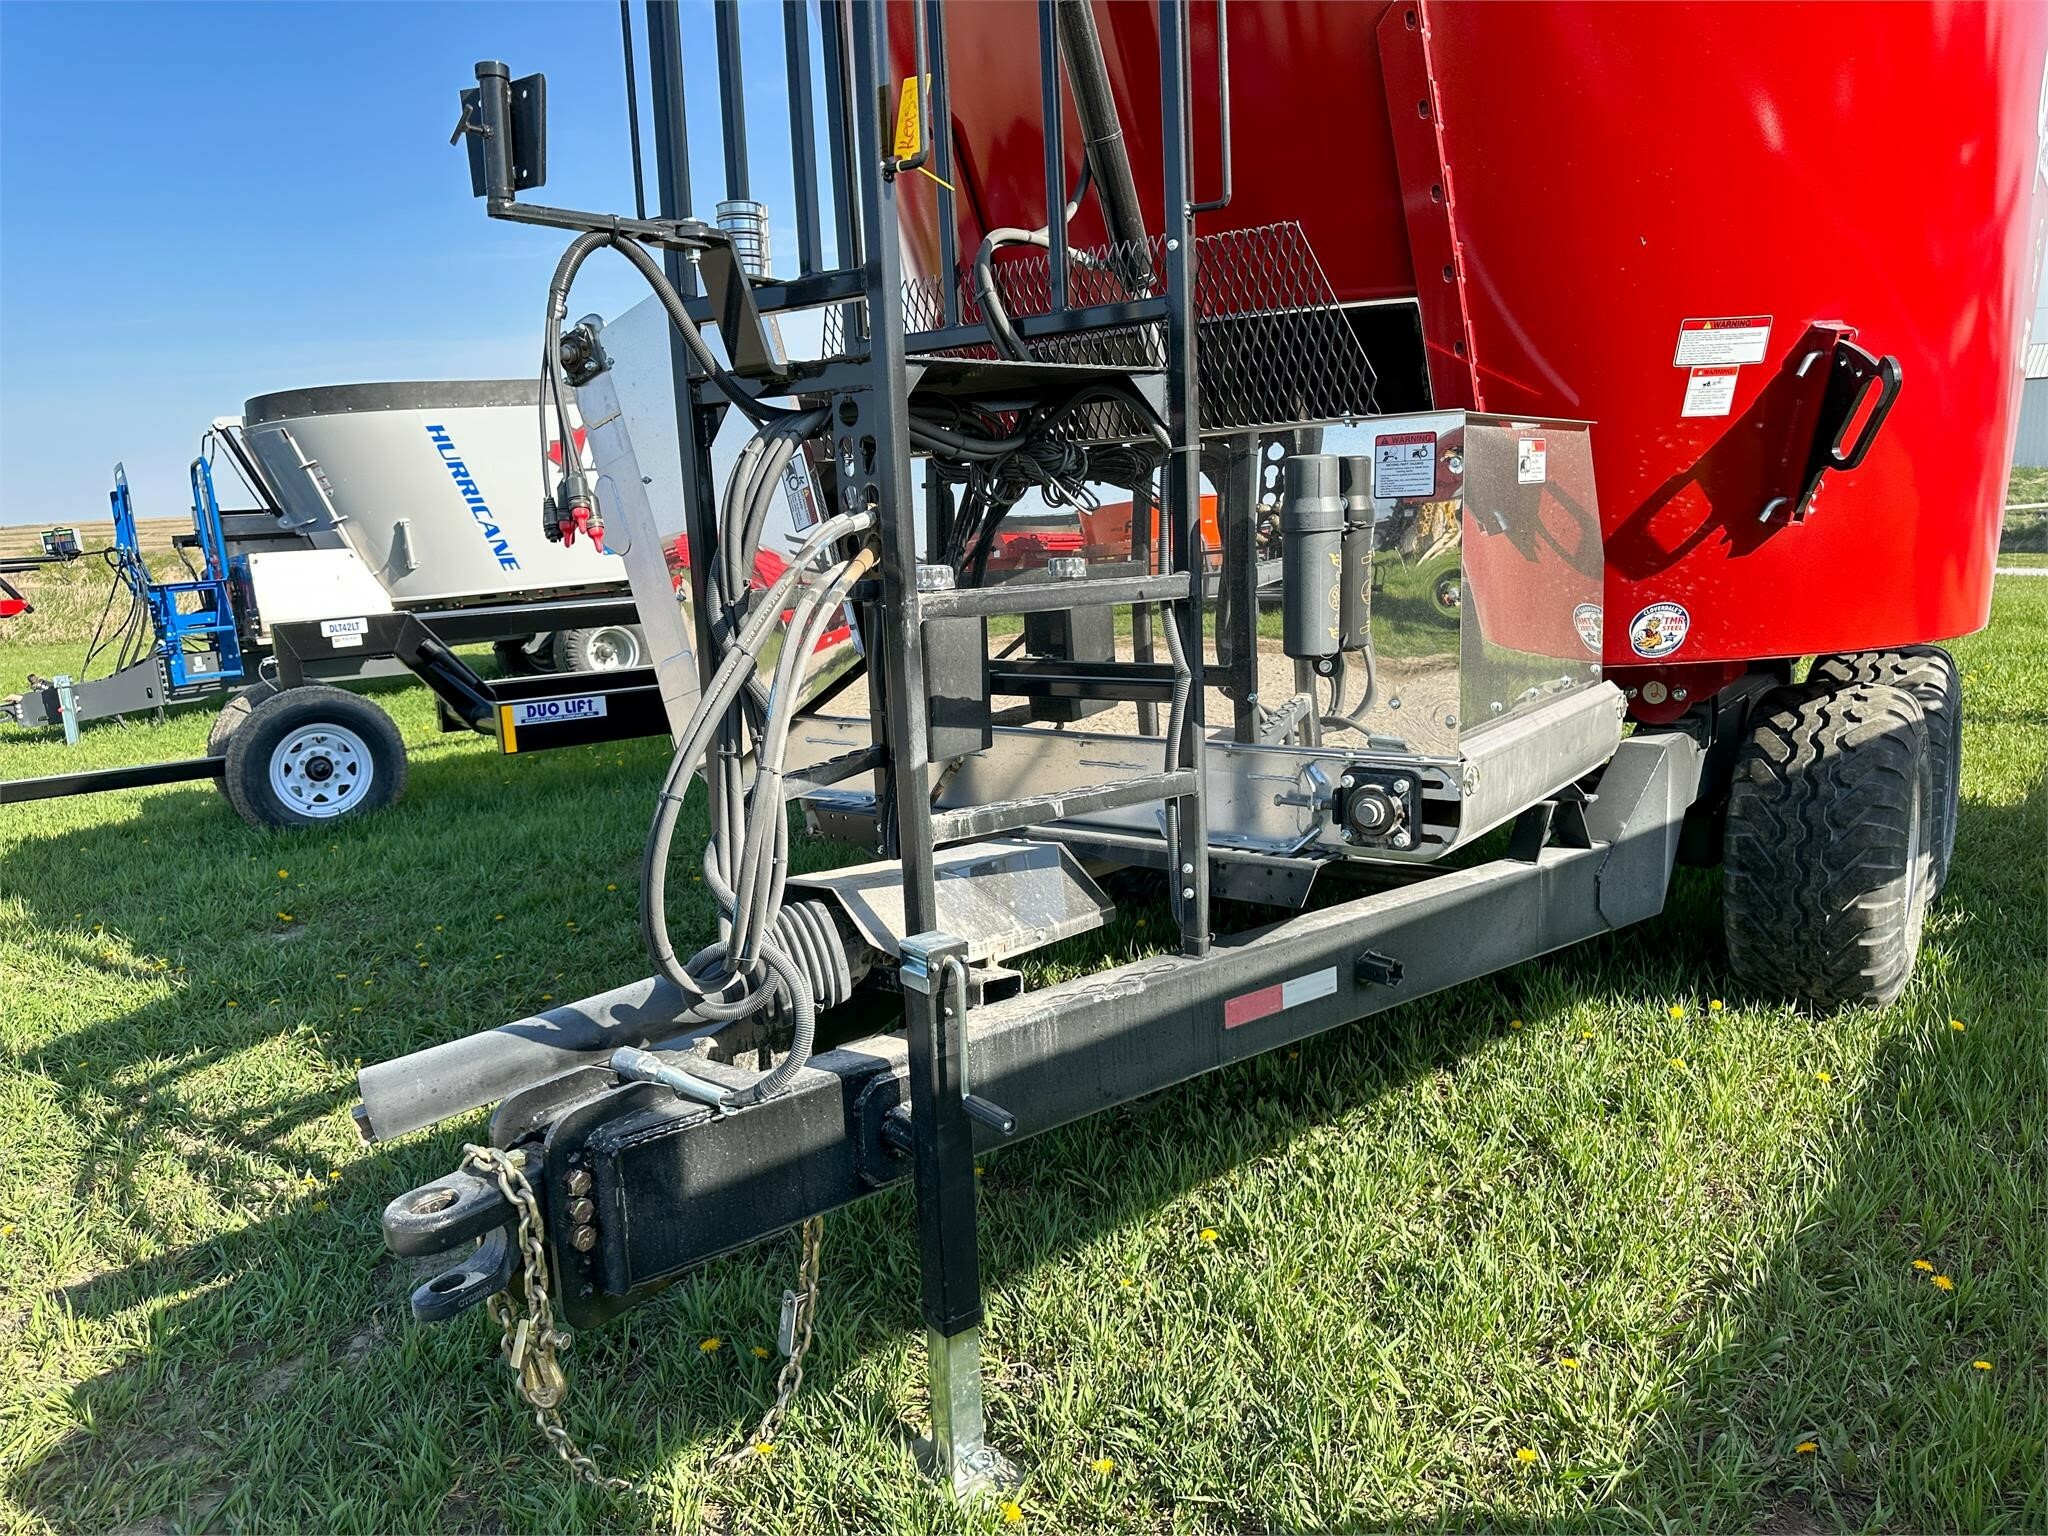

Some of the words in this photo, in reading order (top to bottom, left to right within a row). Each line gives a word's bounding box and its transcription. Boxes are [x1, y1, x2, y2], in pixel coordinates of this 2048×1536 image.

[1713, 320, 1751, 328] WARNING
[1391, 434, 1432, 444] WARNING
[425, 424, 521, 571] HURRICANE
[1663, 616, 1684, 625] TMR
[329, 622, 360, 633] DLT42LT
[1650, 683, 1662, 698] 2
[526, 702, 560, 718] DUO
